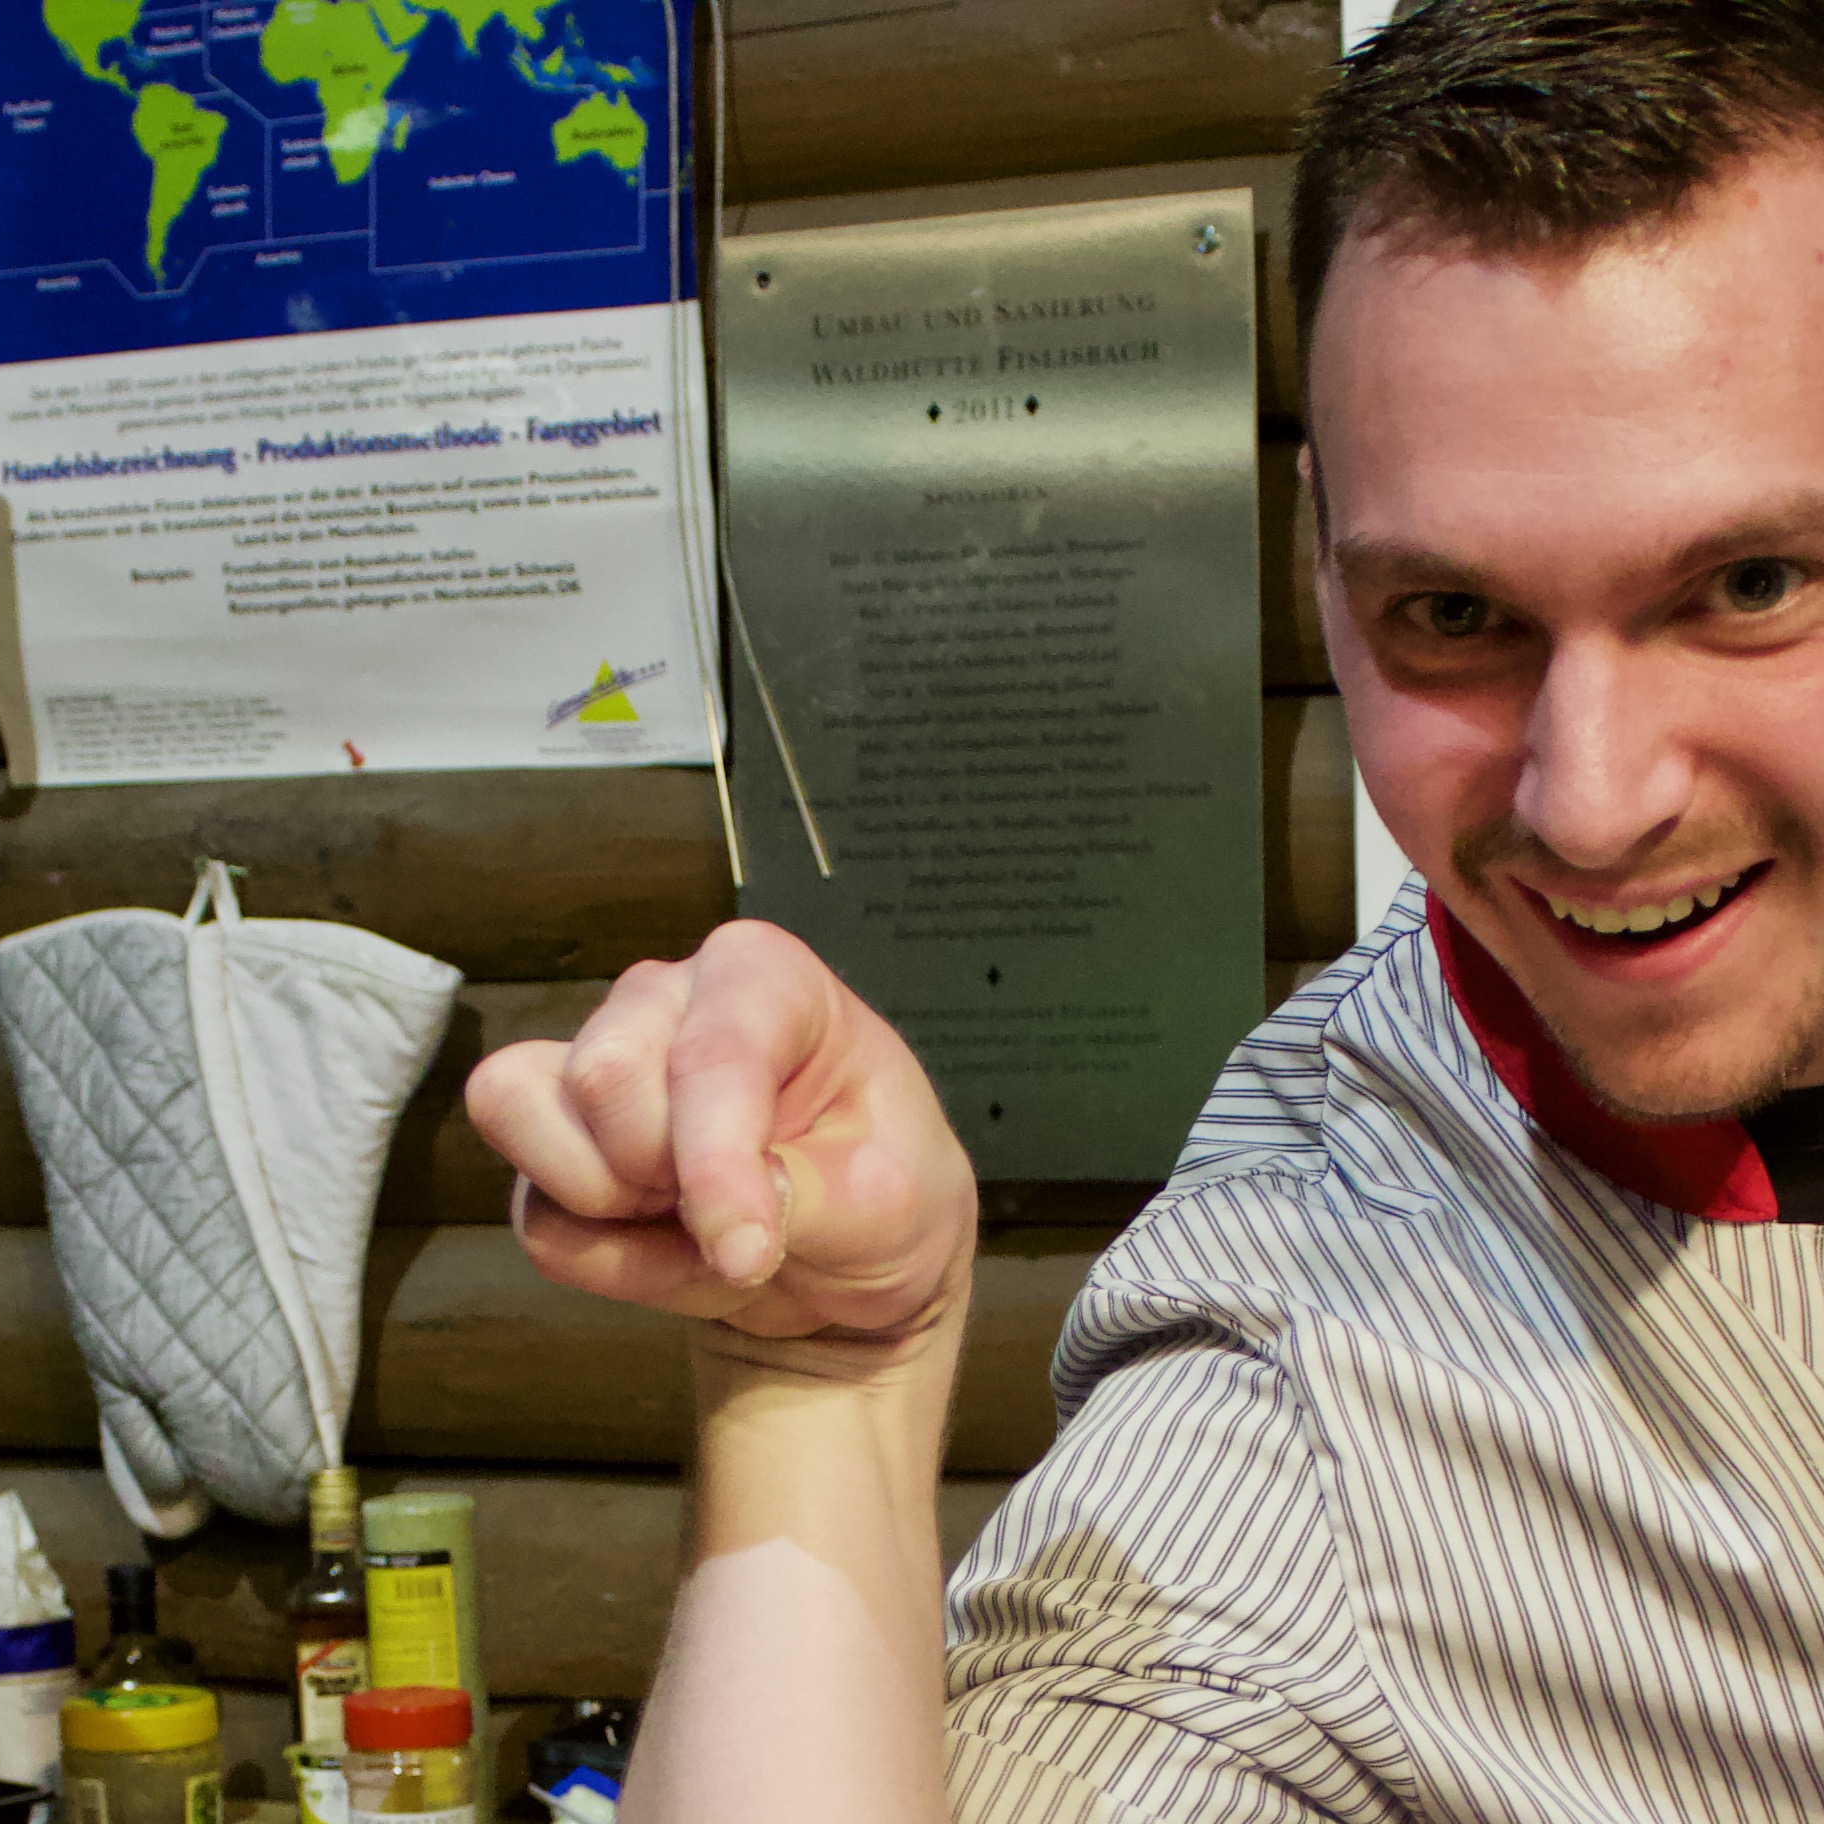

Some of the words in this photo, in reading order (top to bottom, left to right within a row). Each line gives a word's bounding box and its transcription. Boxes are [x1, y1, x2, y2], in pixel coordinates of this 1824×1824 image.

[952, 395, 1017, 423] 2011
[1, 445, 237, 485] Handelsbezeichnung
[257, 418, 502, 463] Produktionsmethode
[526, 407, 662, 449] Fanggebiet
